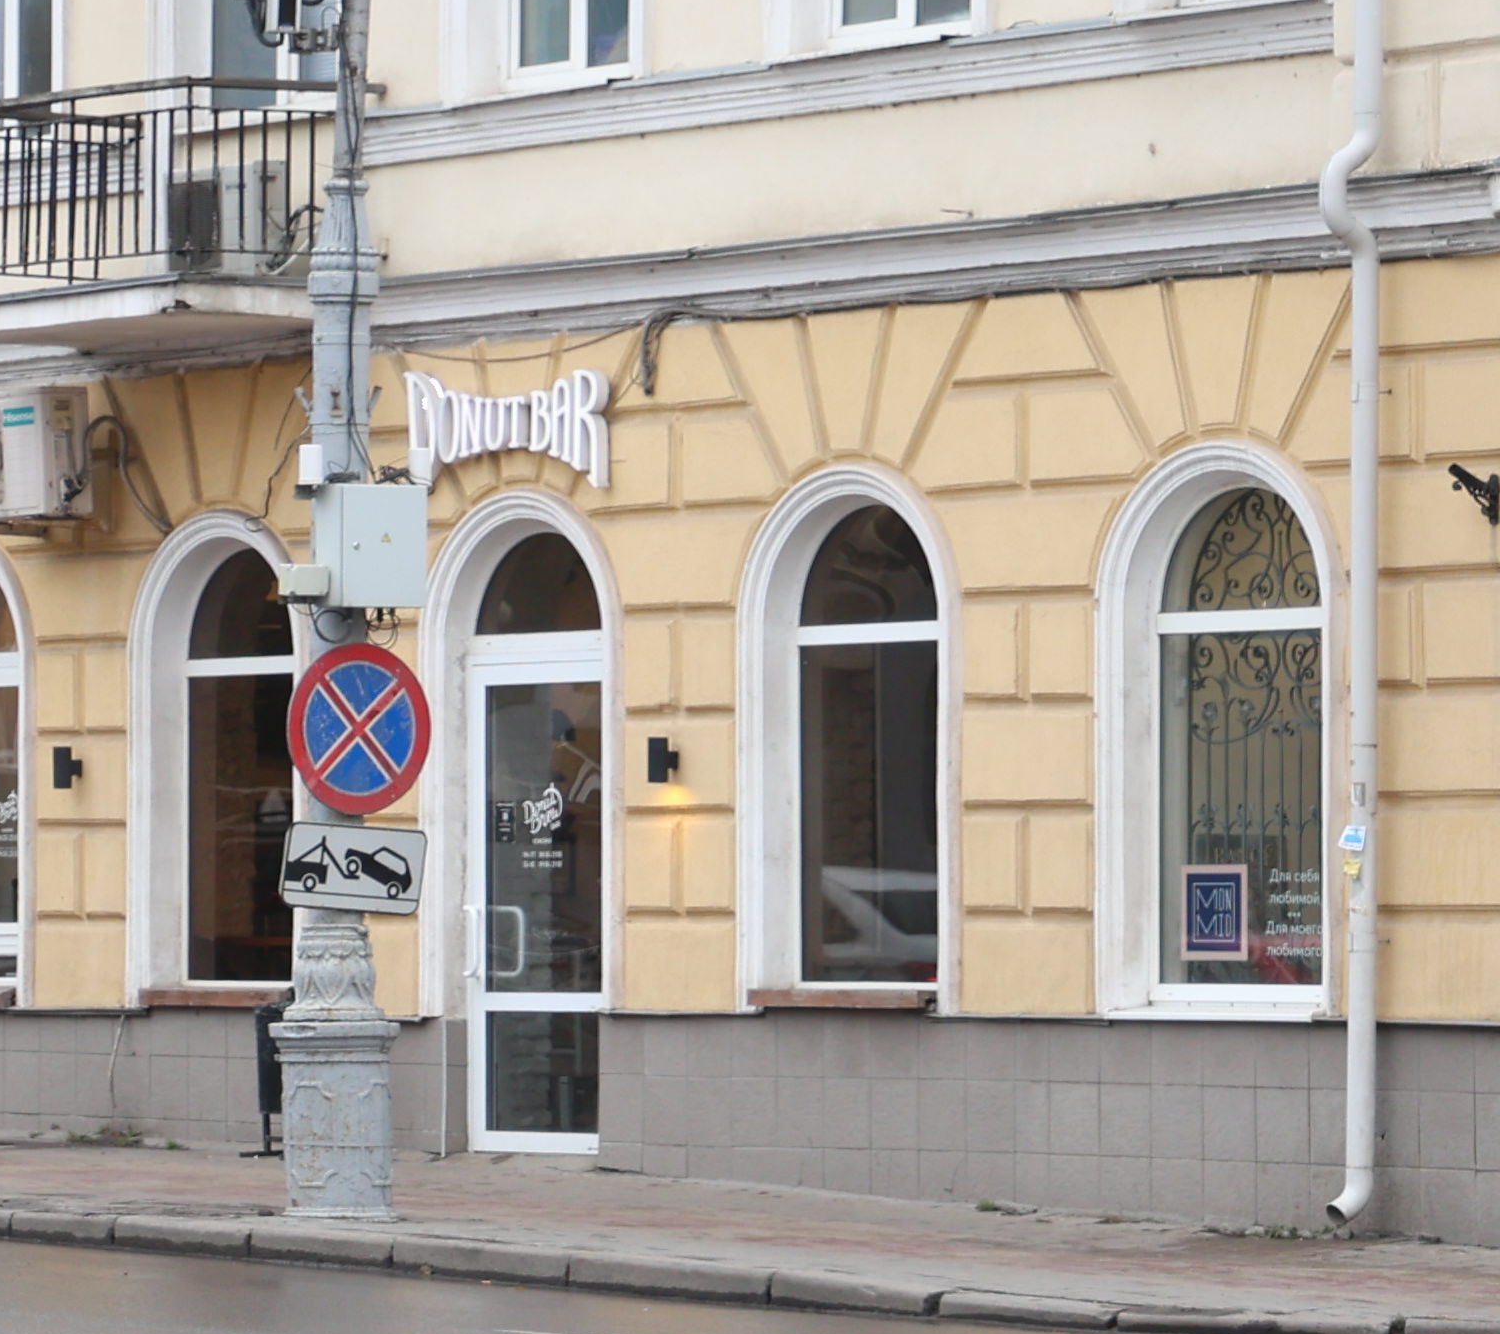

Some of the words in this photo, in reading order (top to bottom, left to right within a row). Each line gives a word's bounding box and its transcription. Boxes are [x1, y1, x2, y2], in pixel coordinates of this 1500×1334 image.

[1269, 868, 1291, 883] Для
[1294, 869, 1320, 883] себя
[1265, 920, 1288, 935] Для
